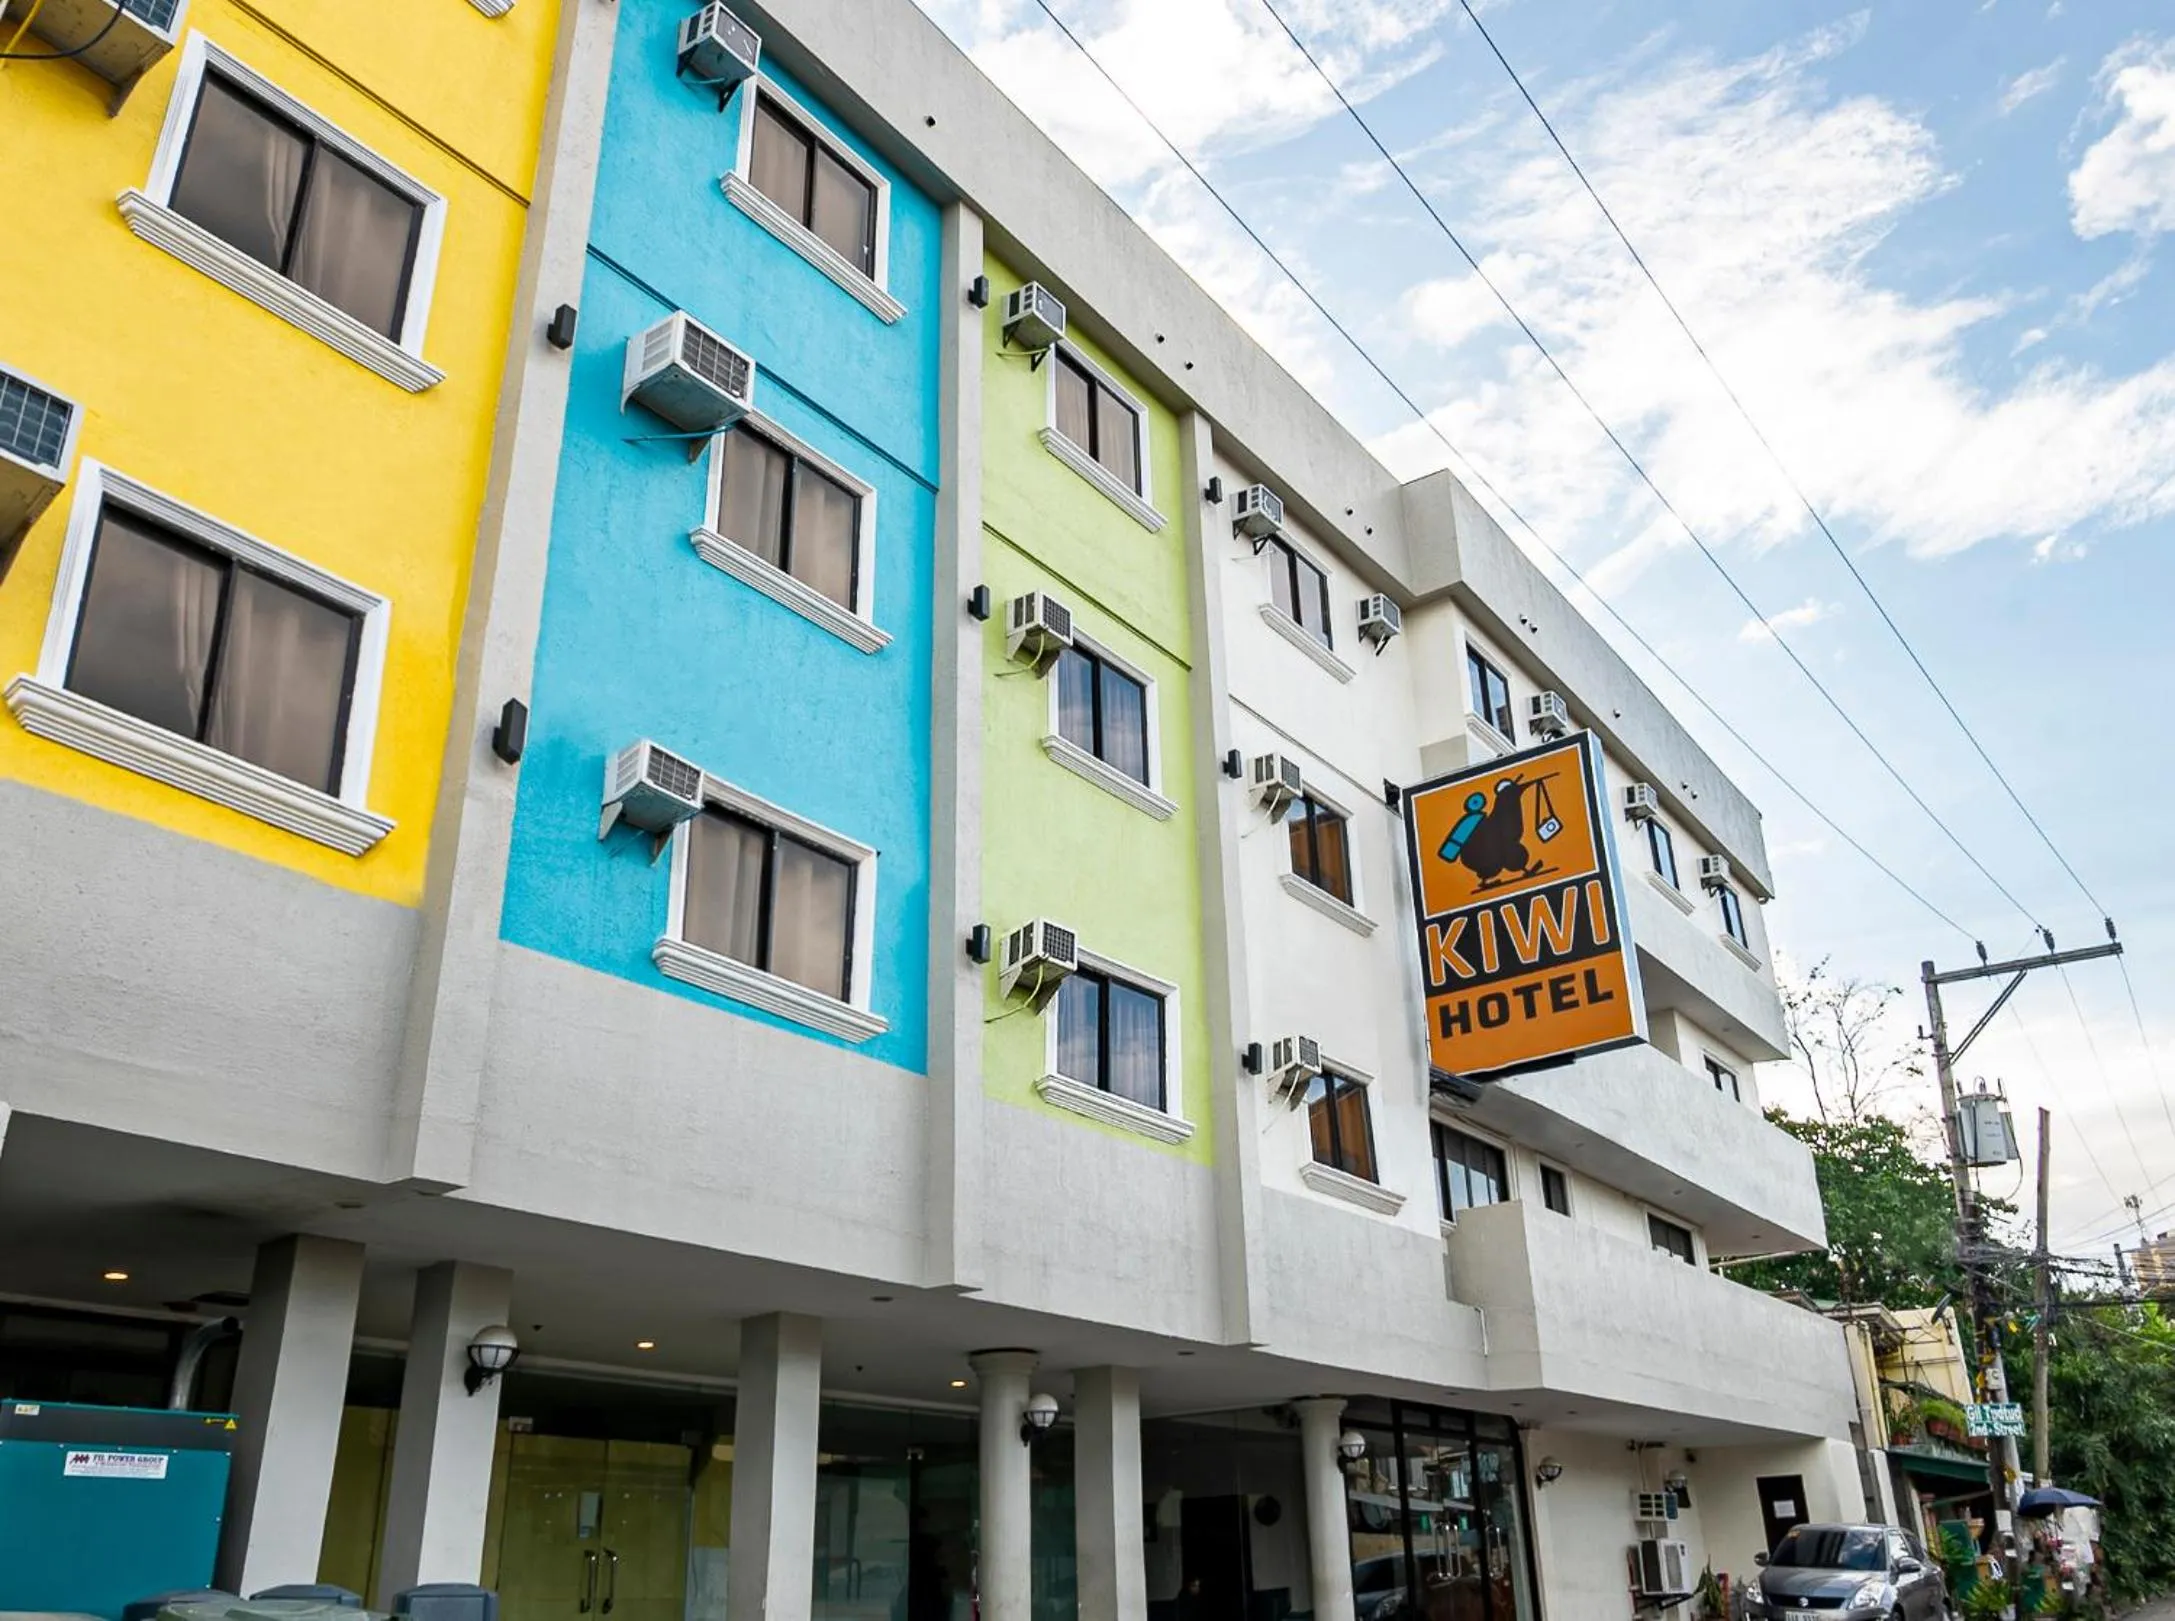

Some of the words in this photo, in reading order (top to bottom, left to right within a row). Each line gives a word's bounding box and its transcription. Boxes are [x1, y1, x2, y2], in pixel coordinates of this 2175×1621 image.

[1425, 880, 1609, 986] KIWI
[1439, 968, 1614, 1039] HOTEL
[108, 1455, 136, 1463] POWER
[137, 1456, 164, 1464] GROUP
